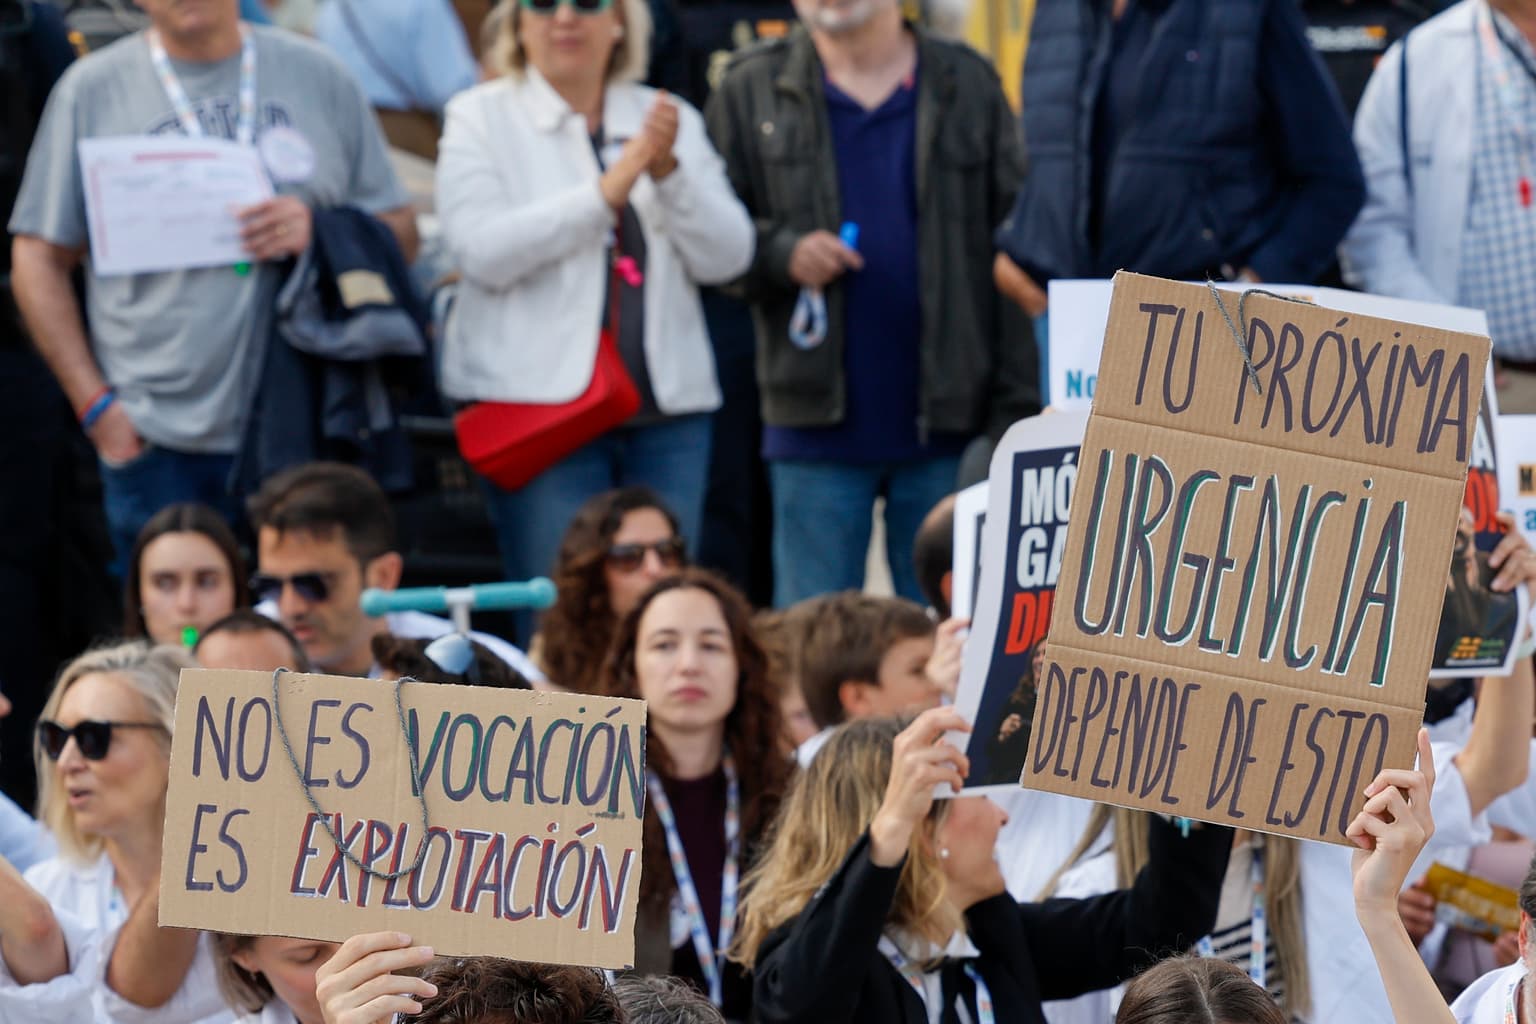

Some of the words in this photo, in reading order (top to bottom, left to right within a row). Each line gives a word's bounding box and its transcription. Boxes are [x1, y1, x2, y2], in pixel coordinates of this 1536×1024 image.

[1135, 304, 1204, 413] TU
[1234, 317, 1470, 462] PRÓXIMA
[1073, 448, 1407, 687] URGENCIA
[192, 695, 272, 782] NO
[303, 699, 374, 788] ES
[407, 706, 646, 819] VOCACIÓN
[1033, 661, 1201, 804] DEPENDE
[1205, 692, 1266, 819] DE
[1265, 703, 1390, 837] ESTO
[185, 804, 250, 893] ES
[289, 812, 636, 934] EXPLOTACIÓN
